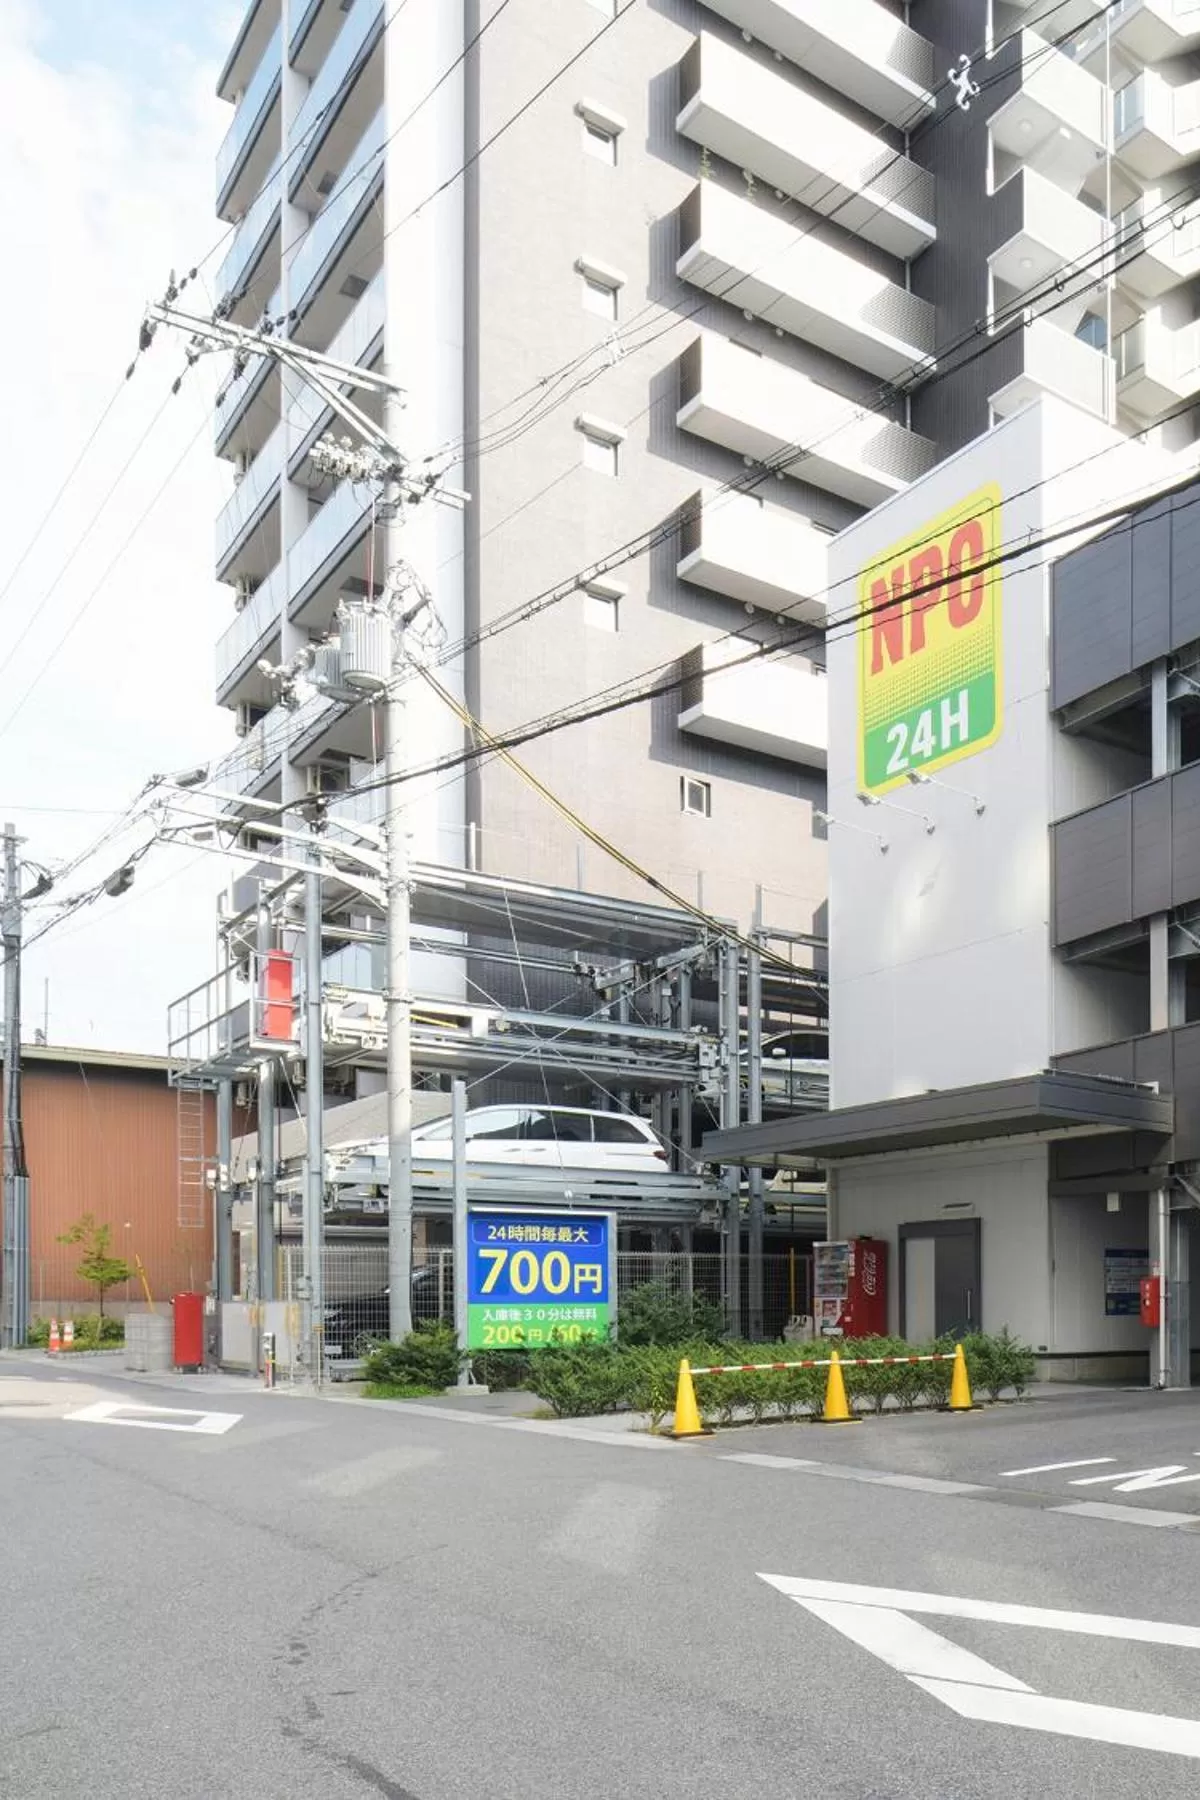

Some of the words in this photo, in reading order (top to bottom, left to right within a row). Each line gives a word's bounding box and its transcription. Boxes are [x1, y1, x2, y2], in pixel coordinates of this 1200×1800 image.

[871, 520, 984, 676] NPC
[886, 689, 969, 775] 24H
[487, 1225, 588, 1243] 24時間毎最大
[479, 1248, 603, 1294] 700円
